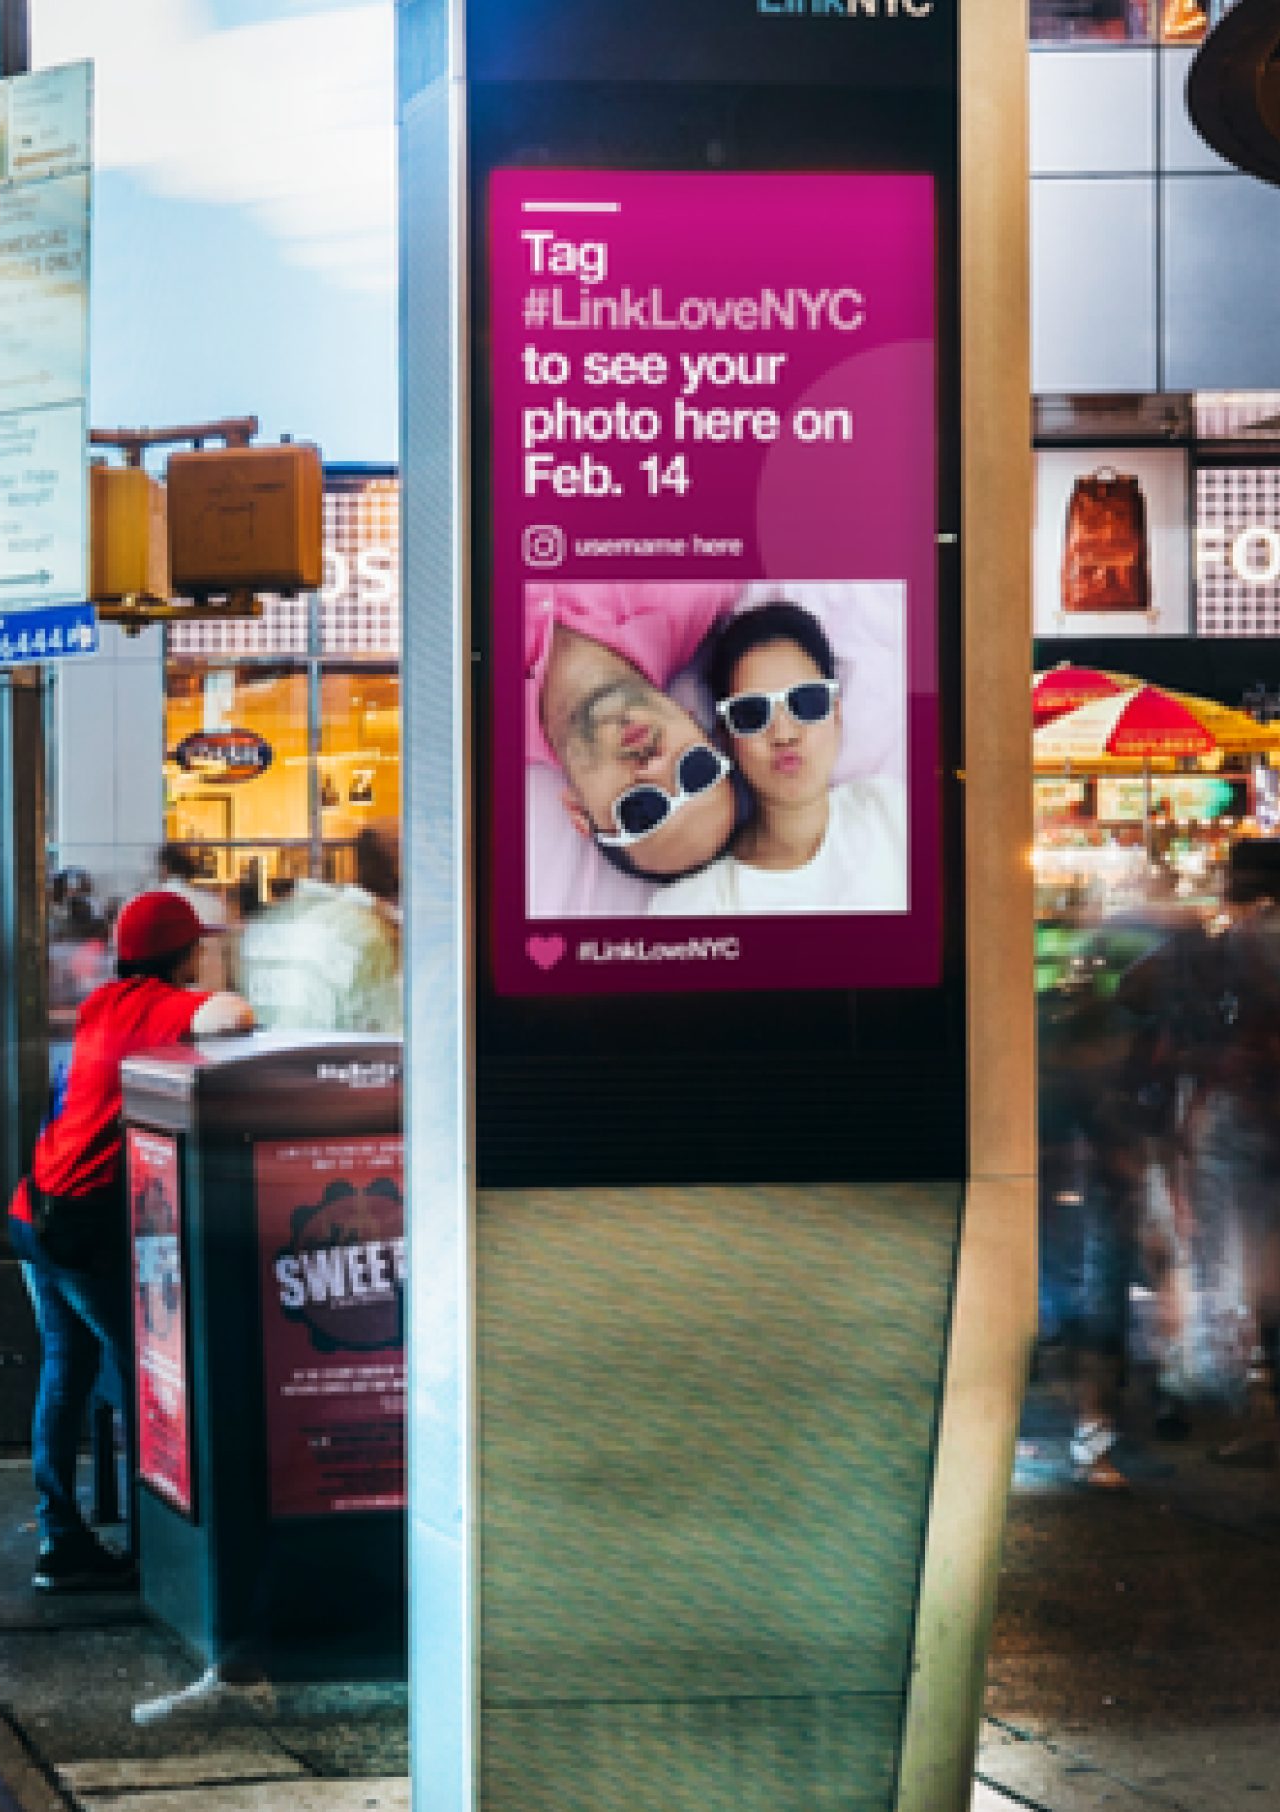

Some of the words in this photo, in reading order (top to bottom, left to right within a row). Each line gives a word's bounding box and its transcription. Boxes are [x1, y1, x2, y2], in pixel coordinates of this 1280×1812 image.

[521, 229, 608, 284] Tag
[522, 286, 865, 330] #LinkLoveNYC
[522, 345, 570, 384] to
[583, 352, 668, 384] see
[680, 353, 786, 394] your
[523, 398, 662, 448] photo
[674, 398, 781, 441] here
[793, 408, 853, 441] on
[523, 453, 623, 496] Feb.
[640, 456, 691, 496] 14
[575, 539, 686, 557] username
[693, 536, 744, 557] here
[1192, 528, 1280, 583] FO
[577, 937, 740, 963] #LinkLoveNYC
